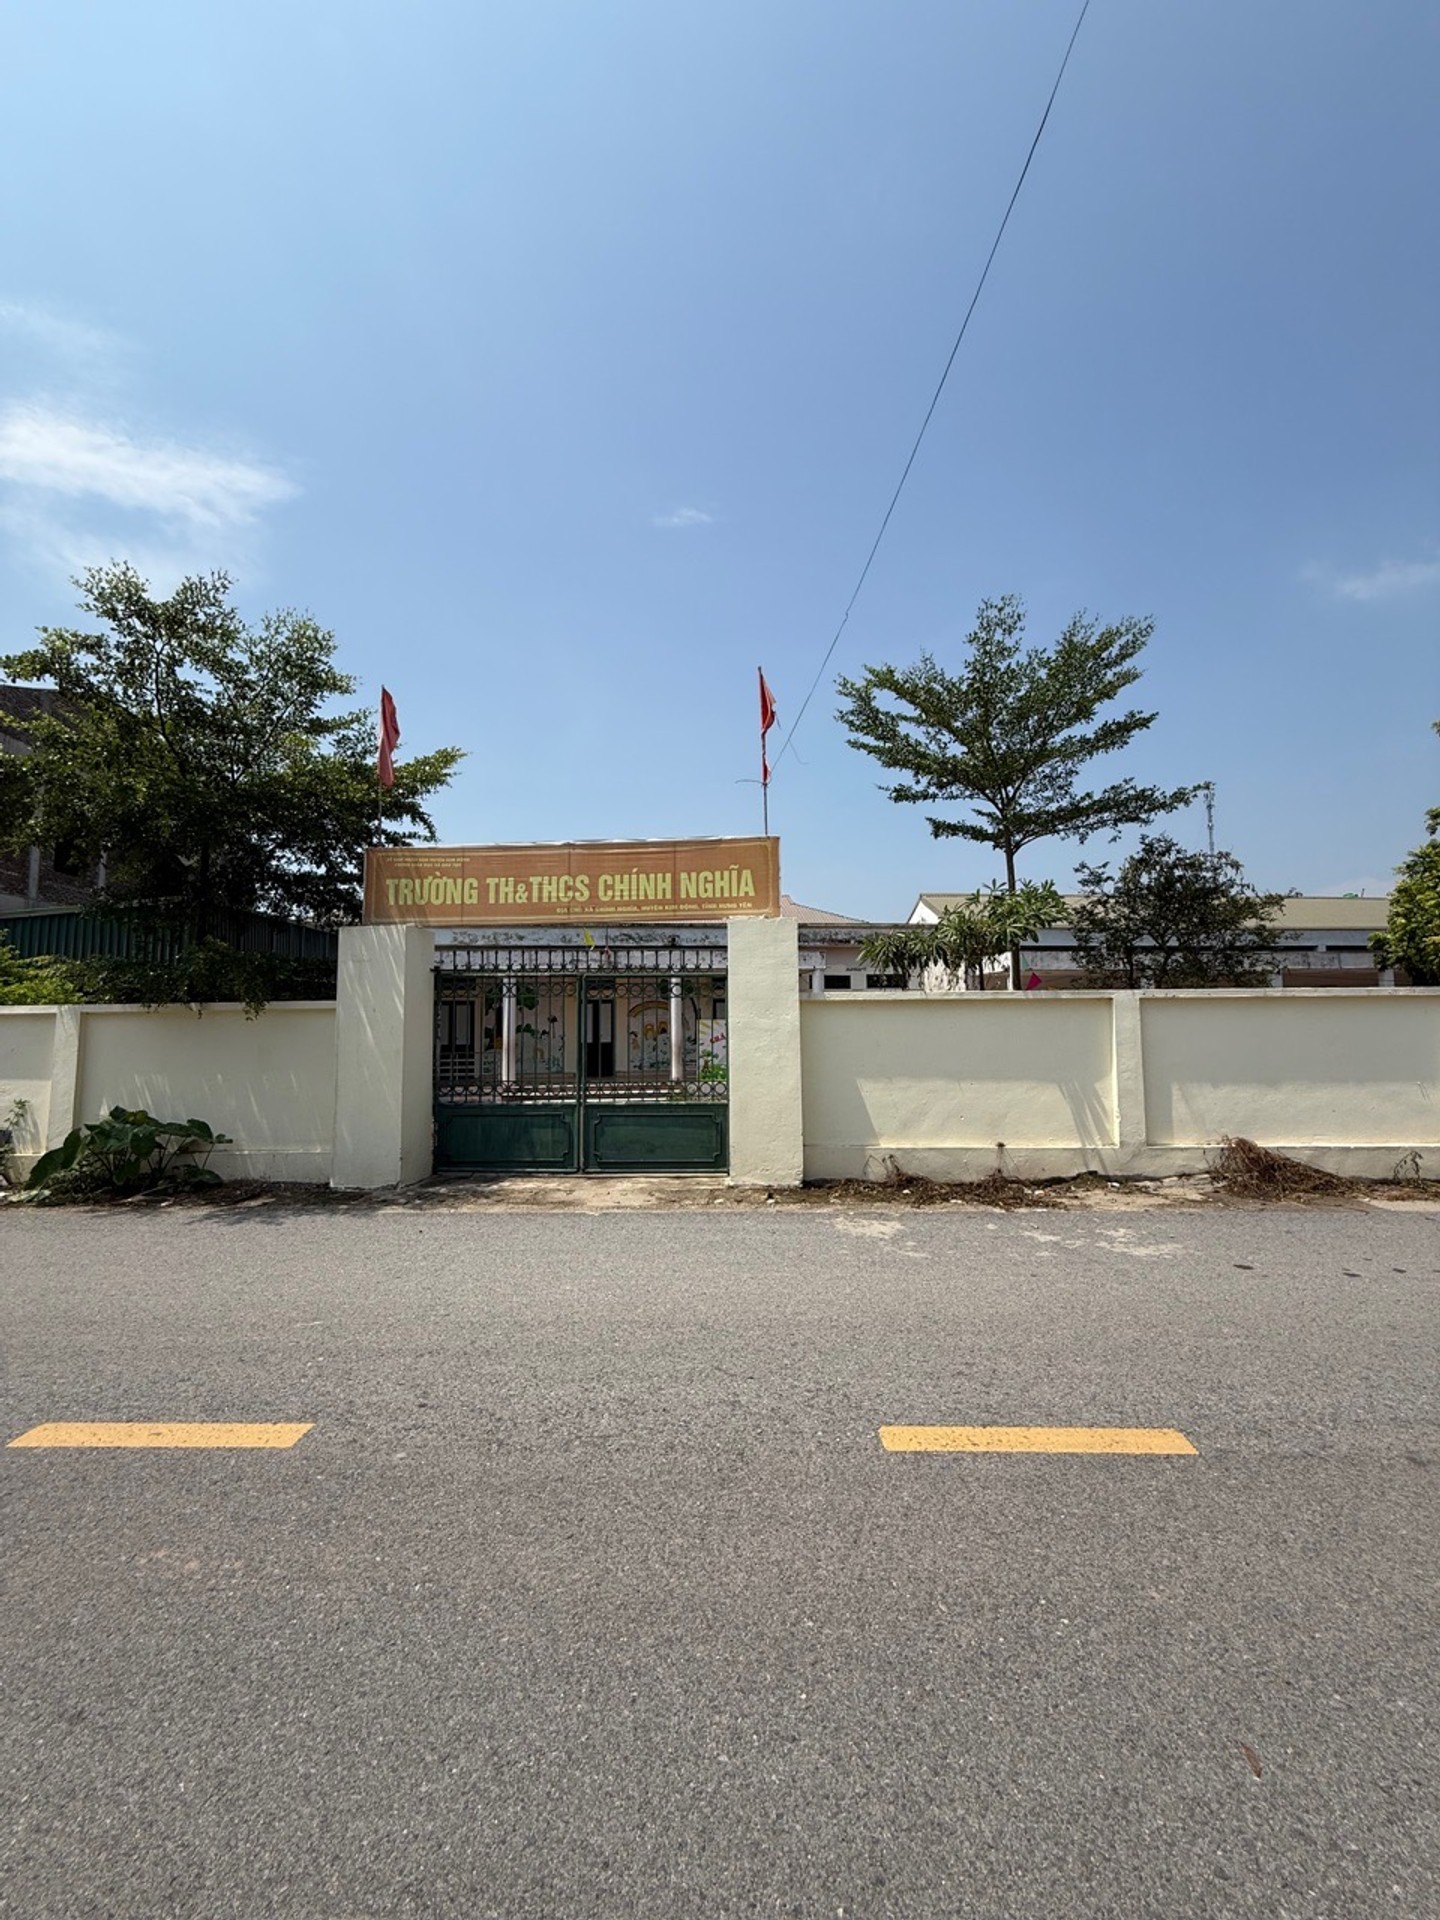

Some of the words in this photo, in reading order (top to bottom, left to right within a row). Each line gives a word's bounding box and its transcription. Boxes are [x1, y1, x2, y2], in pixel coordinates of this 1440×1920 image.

[386, 871, 478, 905] TRƯỜNG
[598, 867, 672, 901] CHÍNH
[680, 864, 755, 899] NGHĨA
